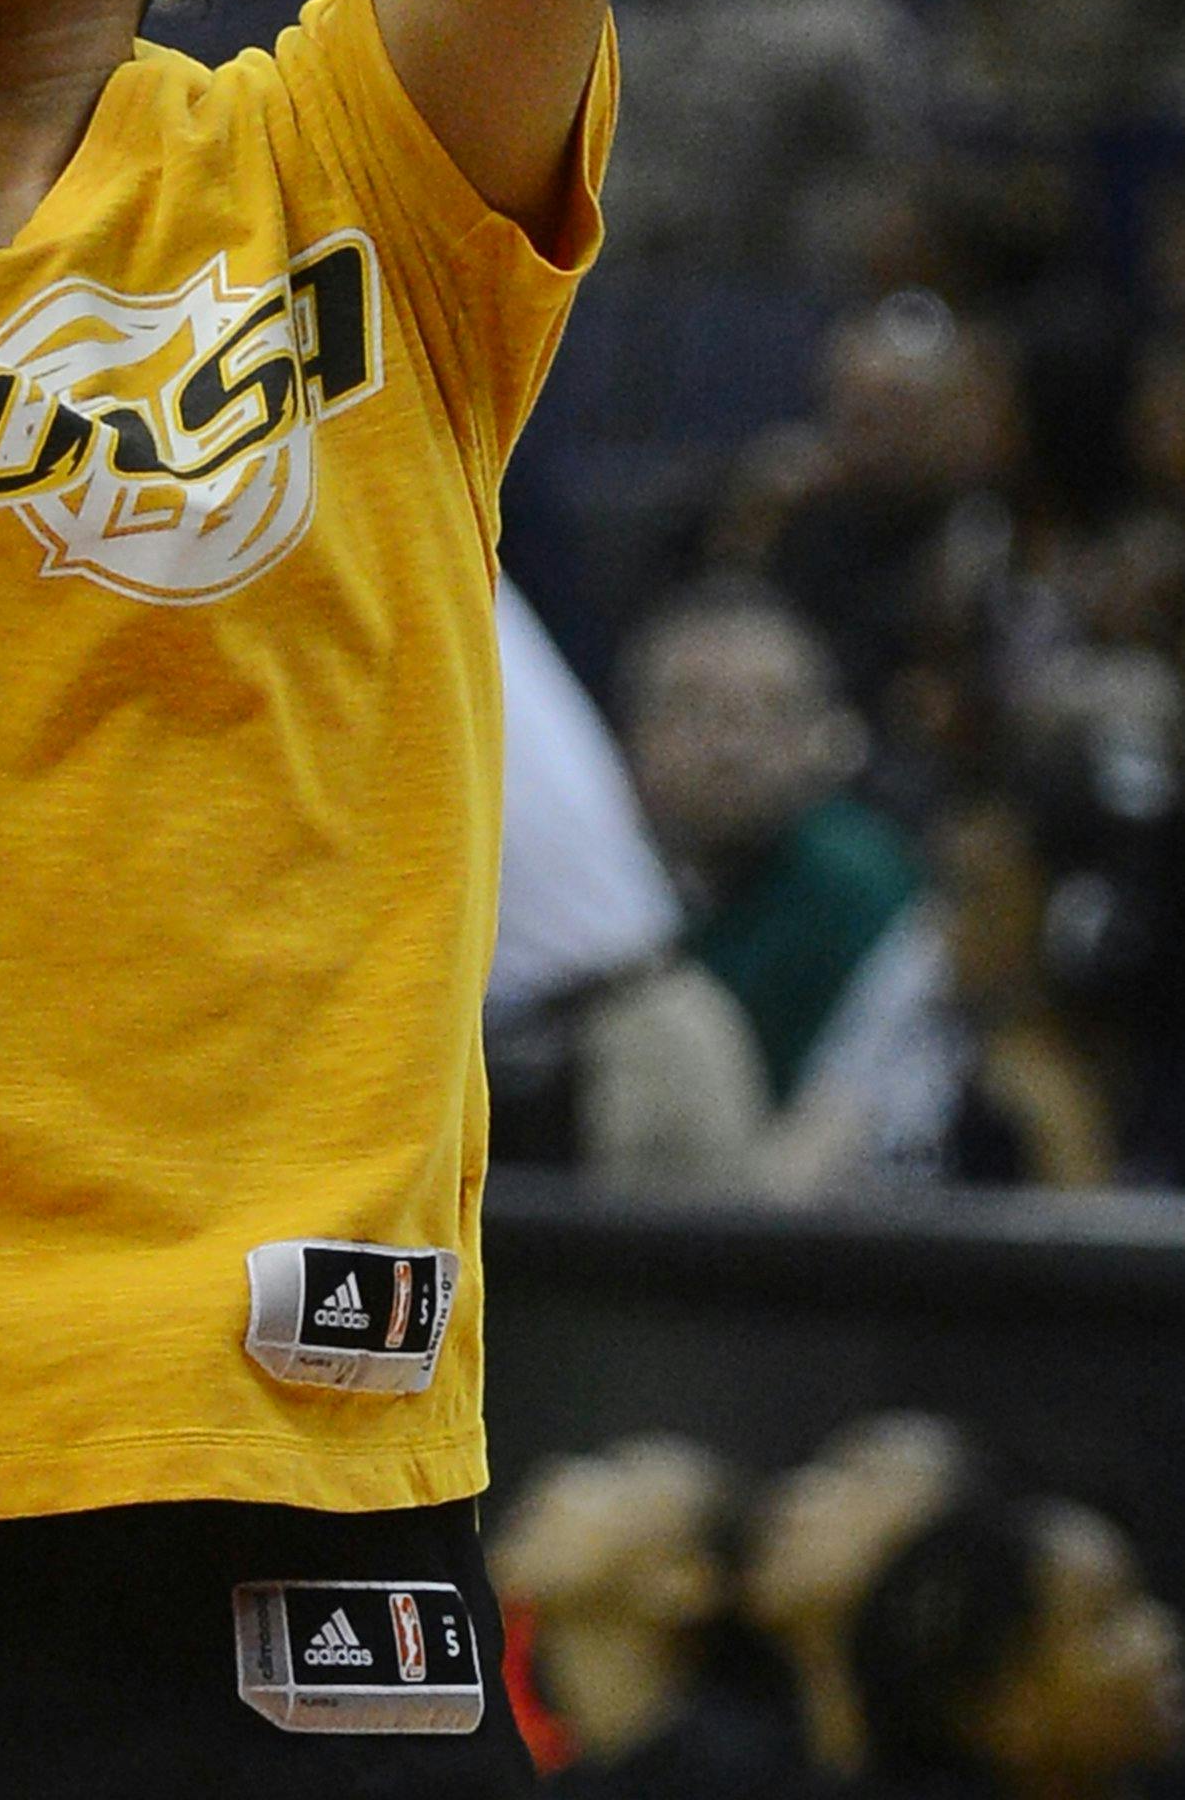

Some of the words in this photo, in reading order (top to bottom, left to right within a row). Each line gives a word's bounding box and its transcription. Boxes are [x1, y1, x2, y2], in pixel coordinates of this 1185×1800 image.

[313, 1307, 371, 1330] adidas
[444, 1629, 461, 1658] S
[304, 1646, 374, 1667] adidas
